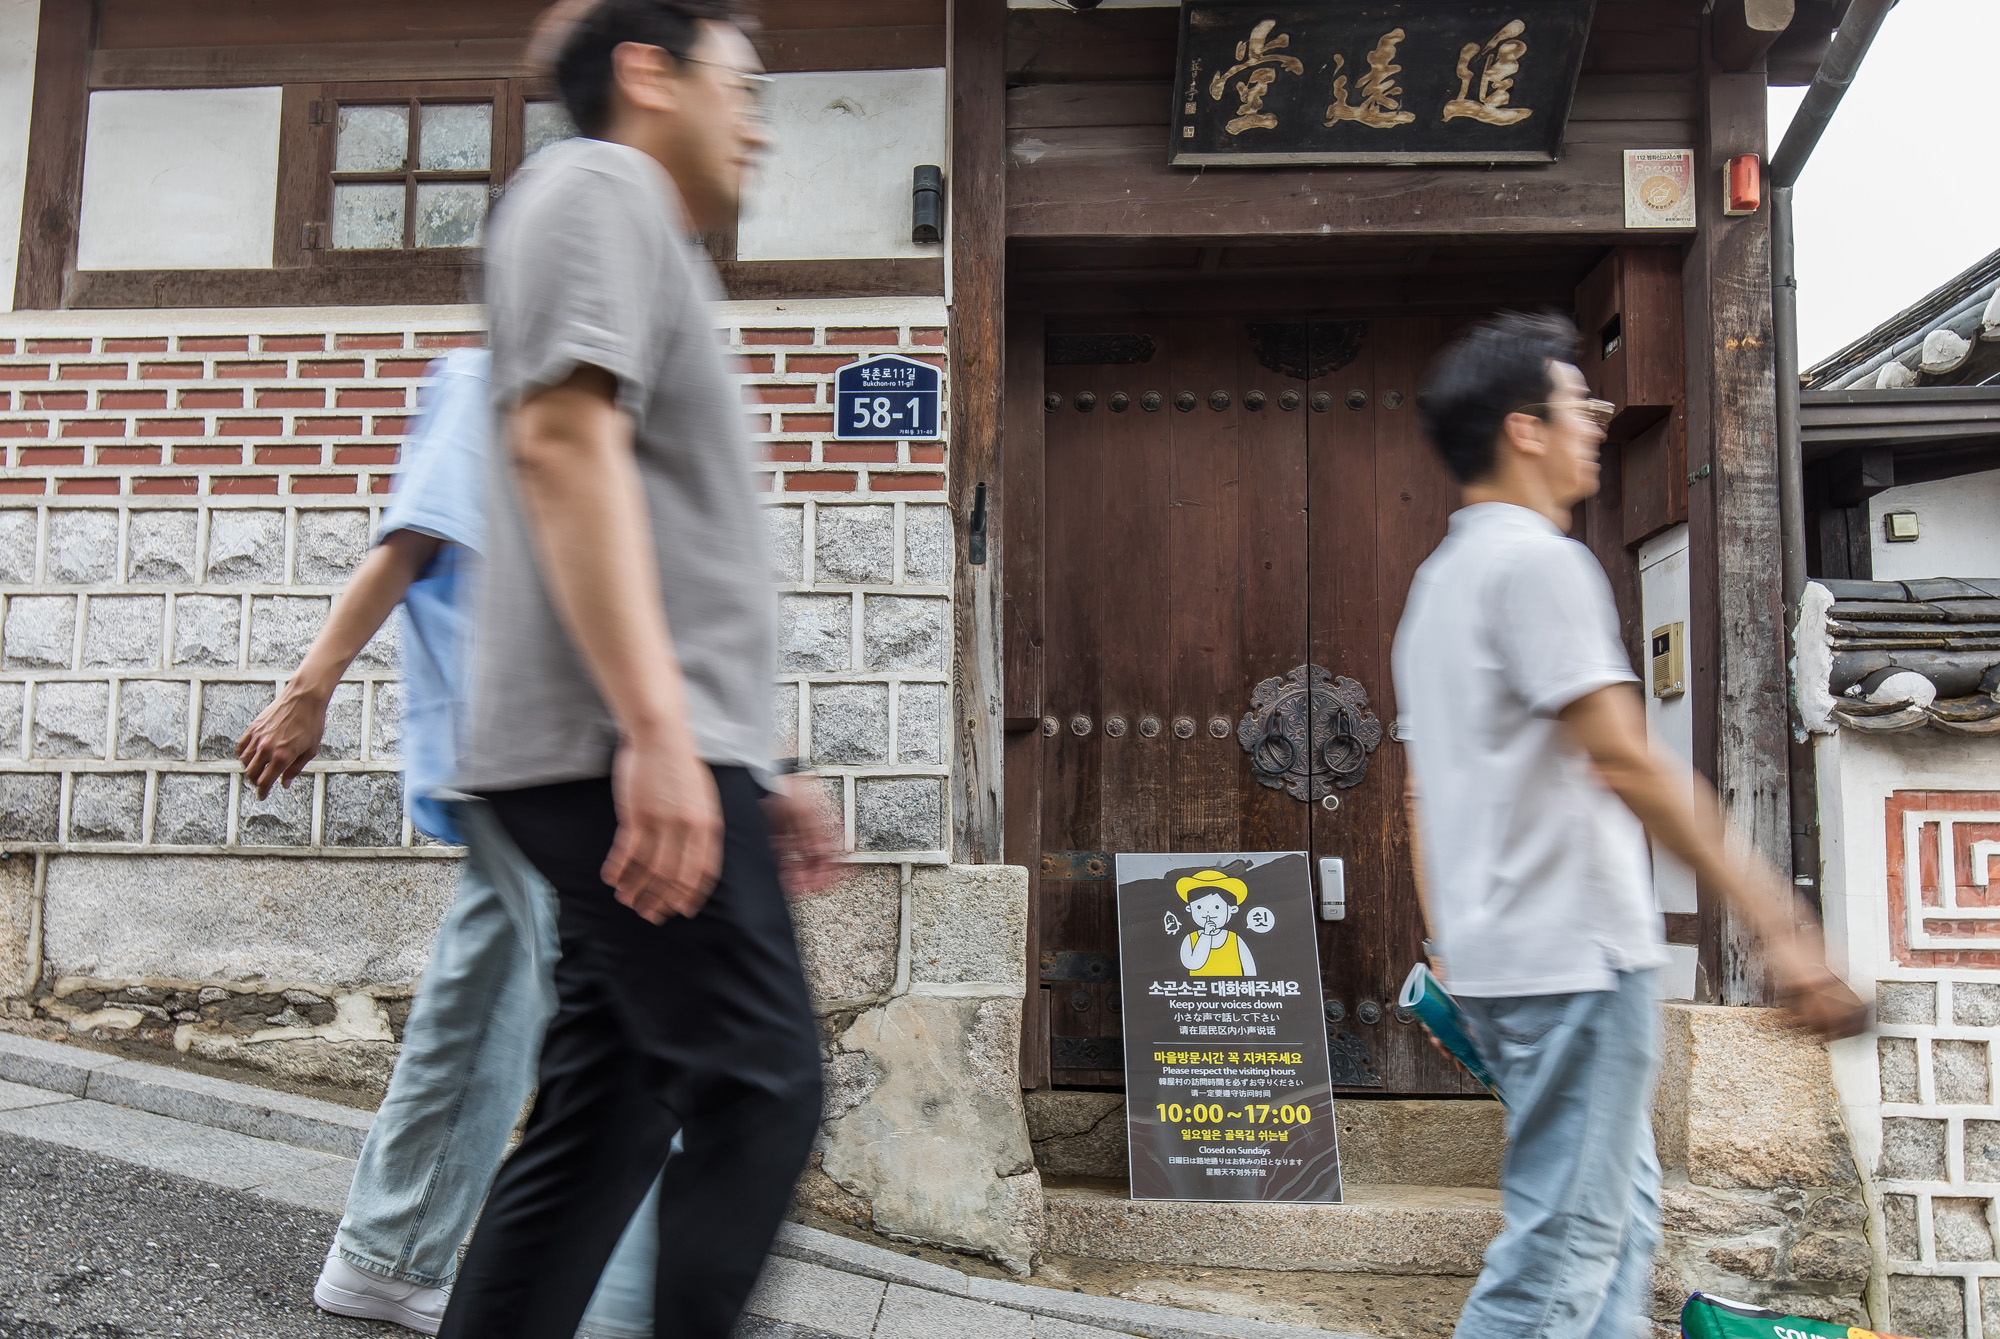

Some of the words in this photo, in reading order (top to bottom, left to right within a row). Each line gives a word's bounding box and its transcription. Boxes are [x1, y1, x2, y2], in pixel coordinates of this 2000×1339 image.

[860, 368, 916, 380] 북촌로11길
[897, 380, 914, 388] 11-gil
[853, 397, 920, 428] 58-1
[1252, 911, 1269, 928] 쉿
[1148, 981, 1208, 997] 소곤소곤
[1211, 981, 1301, 997] 대화해주세요
[1169, 999, 1195, 1011] Keep
[1196, 1001, 1220, 1011] your
[1221, 999, 1252, 1009] voices
[1253, 999, 1283, 1009] down
[1173, 1012, 1280, 1023] 小さな声で話して下さい
[1179, 1025, 1277, 1036] 请在居民区内小声说话
[1153, 1051, 1225, 1065] 마을방문시간
[1227, 1052, 1240, 1065] 꼭
[1243, 1052, 1303, 1065] 지켜주세요
[1162, 1066, 1190, 1075] Please
[1190, 1067, 1223, 1077] respect
[1223, 1066, 1237, 1075] the
[1238, 1067, 1270, 1077] visiting
[1271, 1067, 1296, 1076] hours
[1181, 1129, 1222, 1141] 일요일은
[1224, 1129, 1255, 1141] 골목길
[1258, 1130, 1289, 1142] 쉬는날
[1198, 1145, 1225, 1155] Closed
[1226, 1147, 1237, 1155] on
[1237, 1146, 1271, 1157] Sundays
